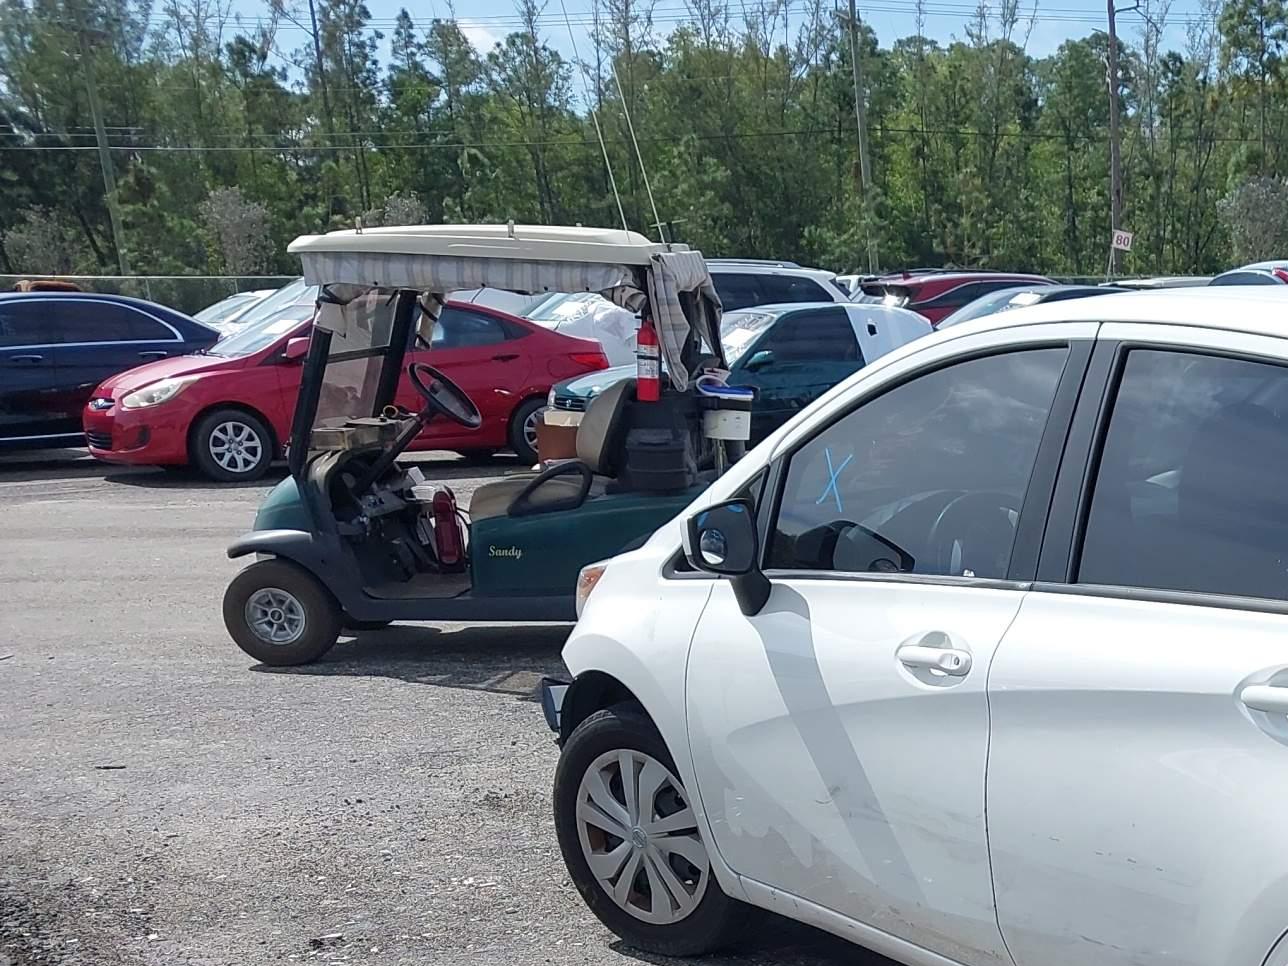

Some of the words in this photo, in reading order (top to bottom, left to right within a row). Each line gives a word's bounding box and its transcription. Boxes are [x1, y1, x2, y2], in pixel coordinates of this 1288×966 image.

[1115, 234, 1130, 247] 80
[816, 448, 854, 513] X
[488, 545, 522, 560] Sandy
